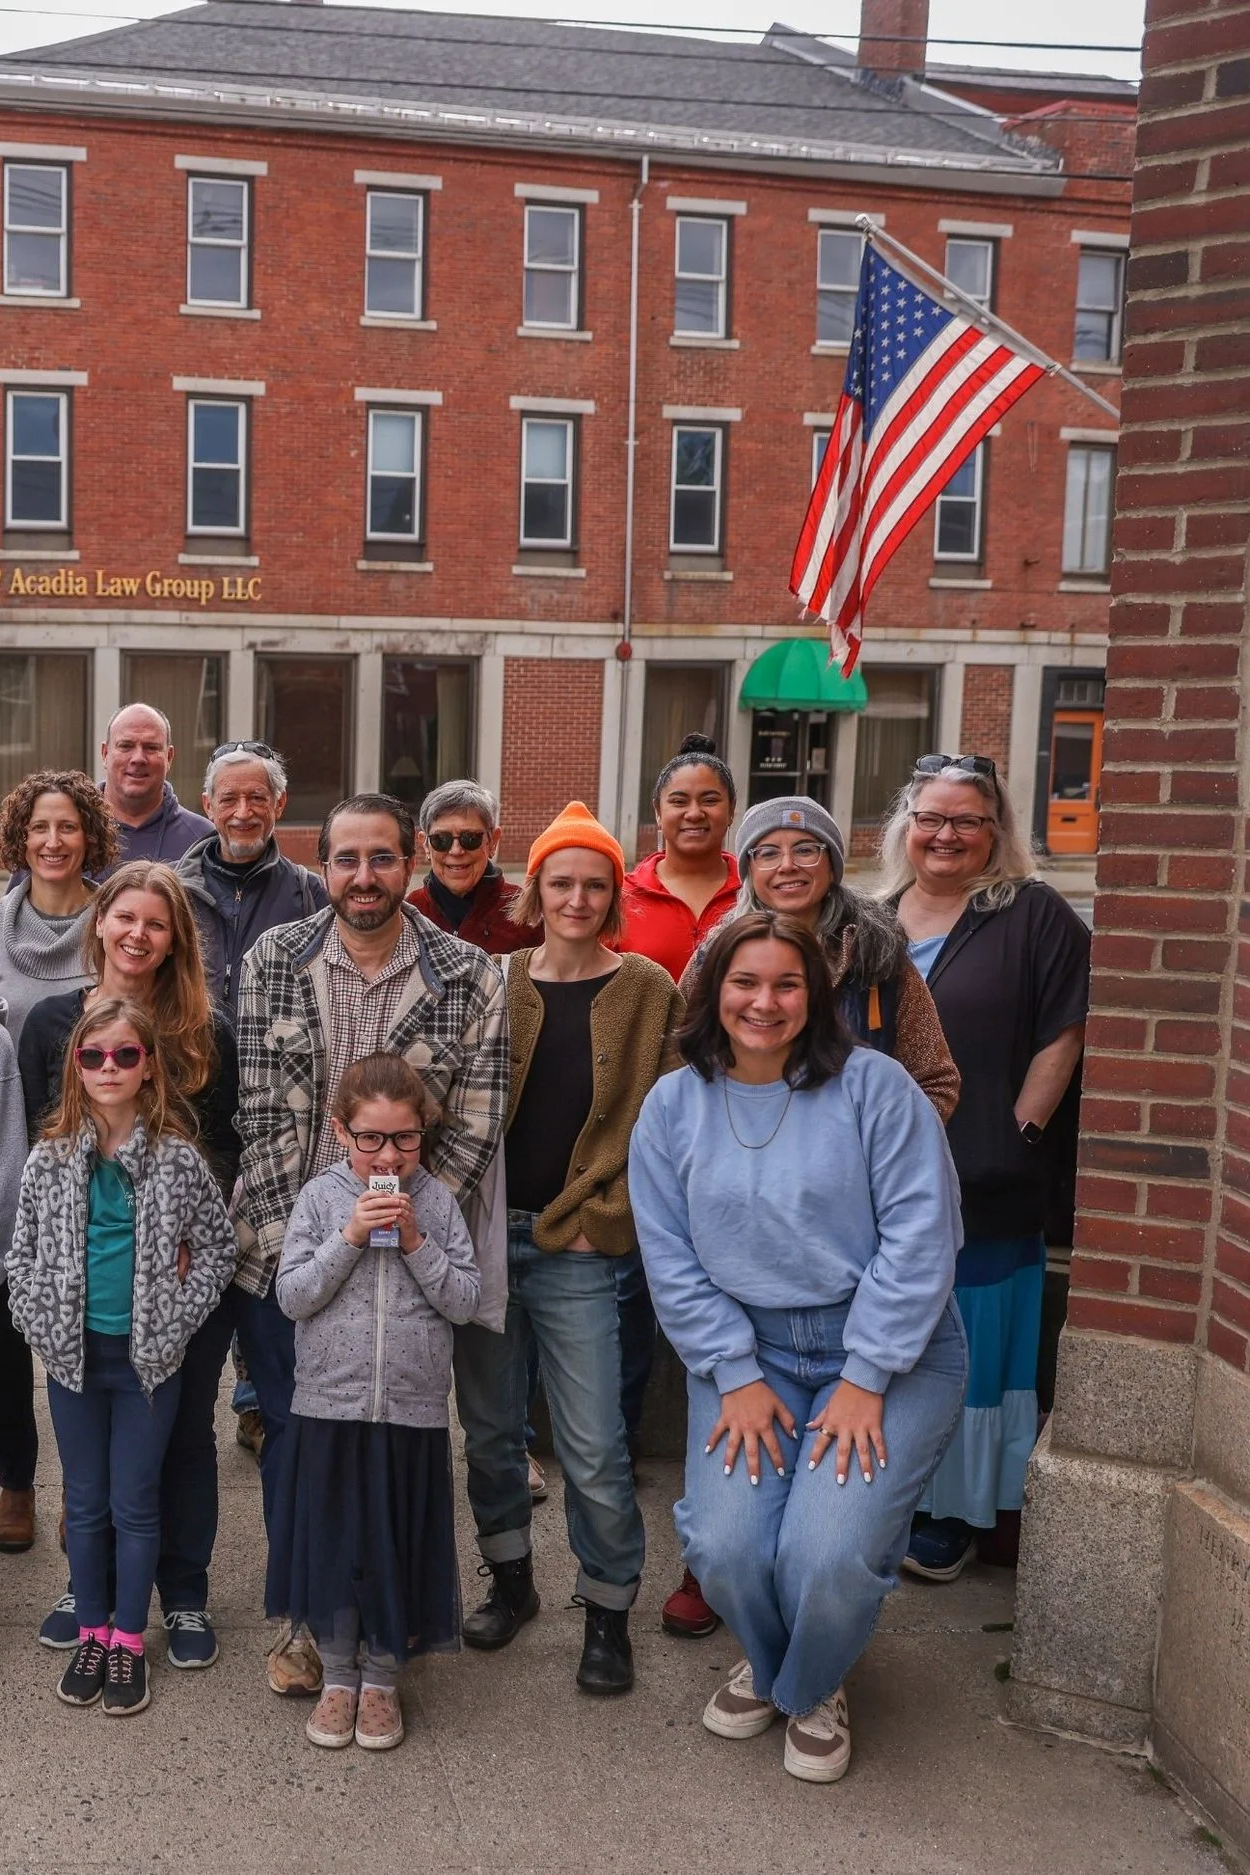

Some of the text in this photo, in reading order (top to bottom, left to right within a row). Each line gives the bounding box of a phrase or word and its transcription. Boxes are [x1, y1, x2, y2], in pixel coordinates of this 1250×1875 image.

[9, 567, 262, 605] Acadia Law Group LLC
[371, 1181, 397, 1191] Juicy
